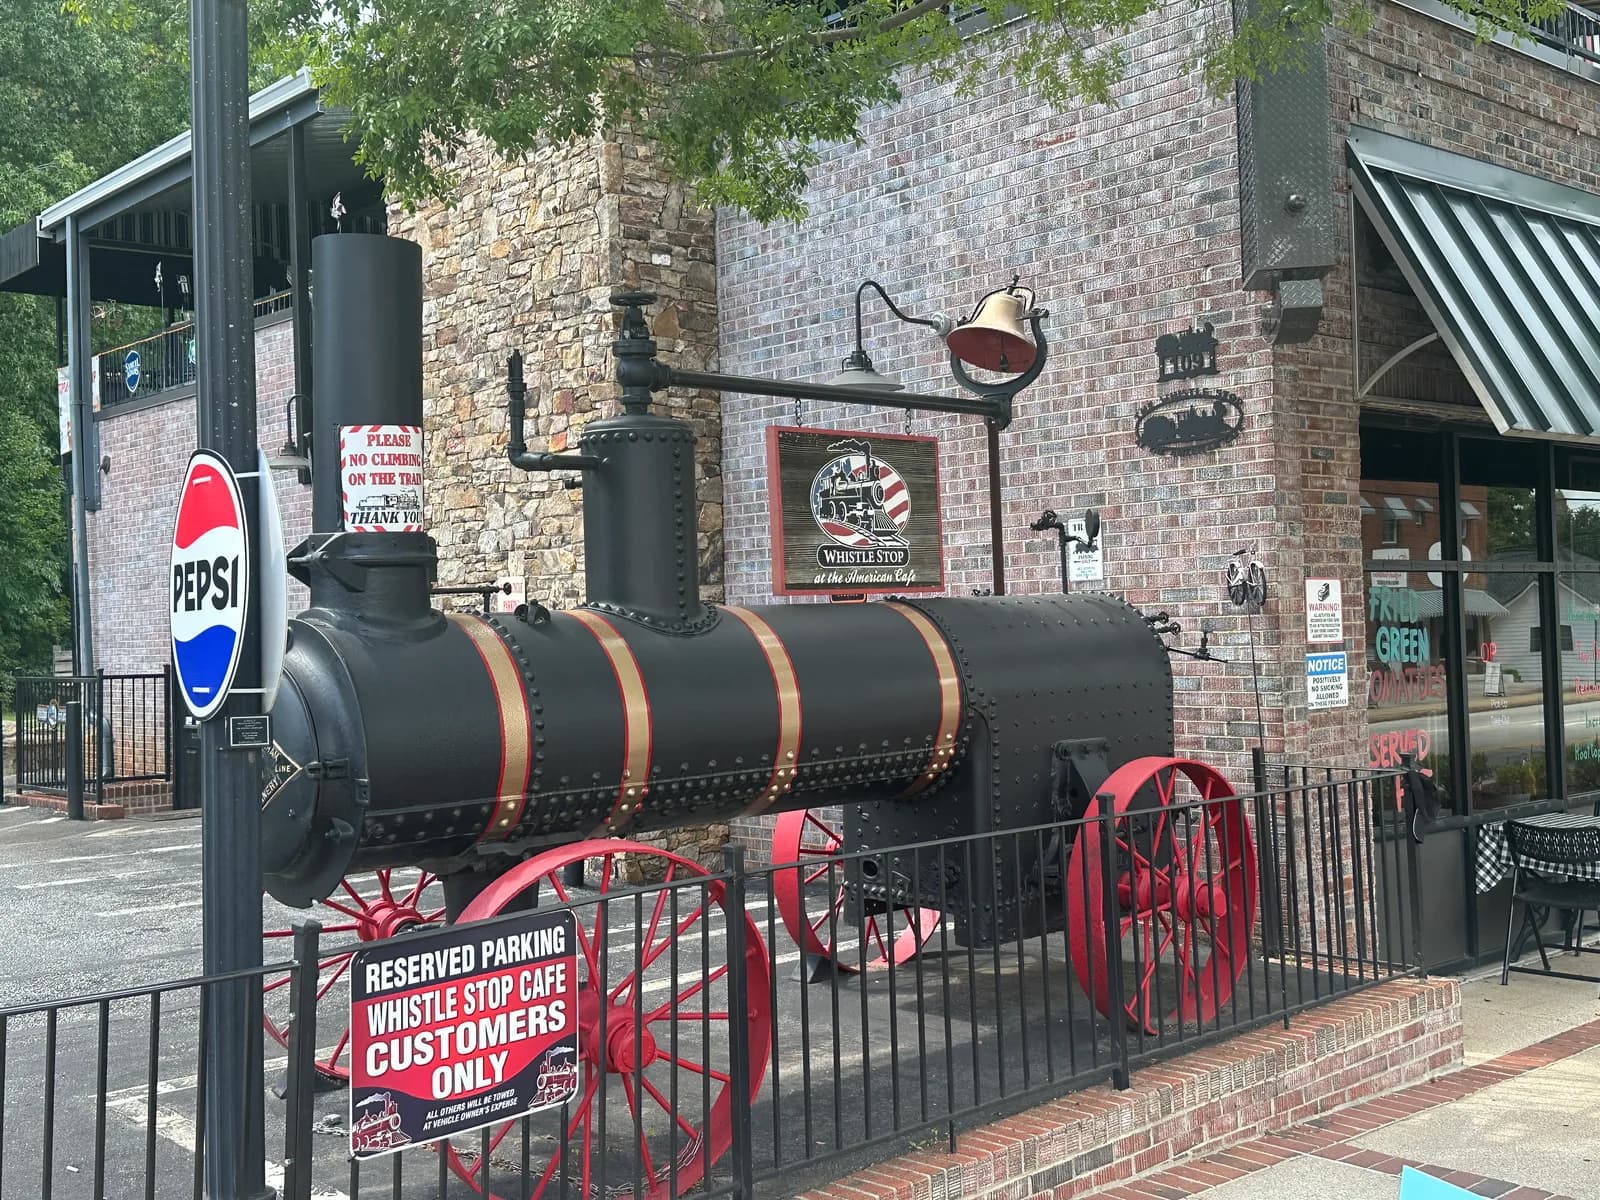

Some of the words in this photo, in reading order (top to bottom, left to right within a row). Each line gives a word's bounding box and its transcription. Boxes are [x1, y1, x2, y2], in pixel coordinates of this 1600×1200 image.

[1216, 389, 1244, 408] STOP
[367, 434, 411, 447] PLEASE
[349, 454, 368, 467] NO
[371, 453, 421, 467] CLIMBING
[348, 473, 366, 486] ON
[369, 472, 396, 485] THE
[350, 511, 400, 524] THANK
[823, 549, 875, 564] WHISTLE
[876, 549, 904, 563] STOP
[173, 554, 239, 613] PEPSI
[813, 571, 826, 584] at
[827, 570, 844, 584] the
[845, 569, 893, 584] American
[894, 568, 916, 587] Cafe
[1308, 602, 1340, 612] WARNING!
[1368, 586, 1420, 624] FRIED
[1375, 625, 1430, 663] GREEN
[1308, 658, 1345, 673] NOTICE
[1312, 676, 1341, 684] POSITIVELY
[1369, 665, 1446, 703] OMATOES
[1316, 692, 1340, 700] ALLOWED
[1369, 729, 1431, 769] SERVED
[365, 944, 475, 994] RESERVED
[482, 925, 565, 970] PARKING
[367, 986, 458, 1037] WHISTLE
[463, 975, 514, 1016] STOP
[520, 963, 567, 1002] CAFE
[366, 1000, 567, 1077] CUSTOMERS
[432, 1051, 510, 1100] ONLY
[422, 1121, 431, 1132] AT
[432, 1114, 460, 1129] VEHICLE
[460, 1105, 490, 1121] OWNER'S
[490, 1097, 518, 1112] EXPENSE
[425, 1109, 439, 1120] ALL
[440, 1102, 466, 1116] OTHERS
[466, 1098, 482, 1109] WILL
[483, 1094, 493, 1104] BE
[493, 1088, 515, 1102] TOWED
